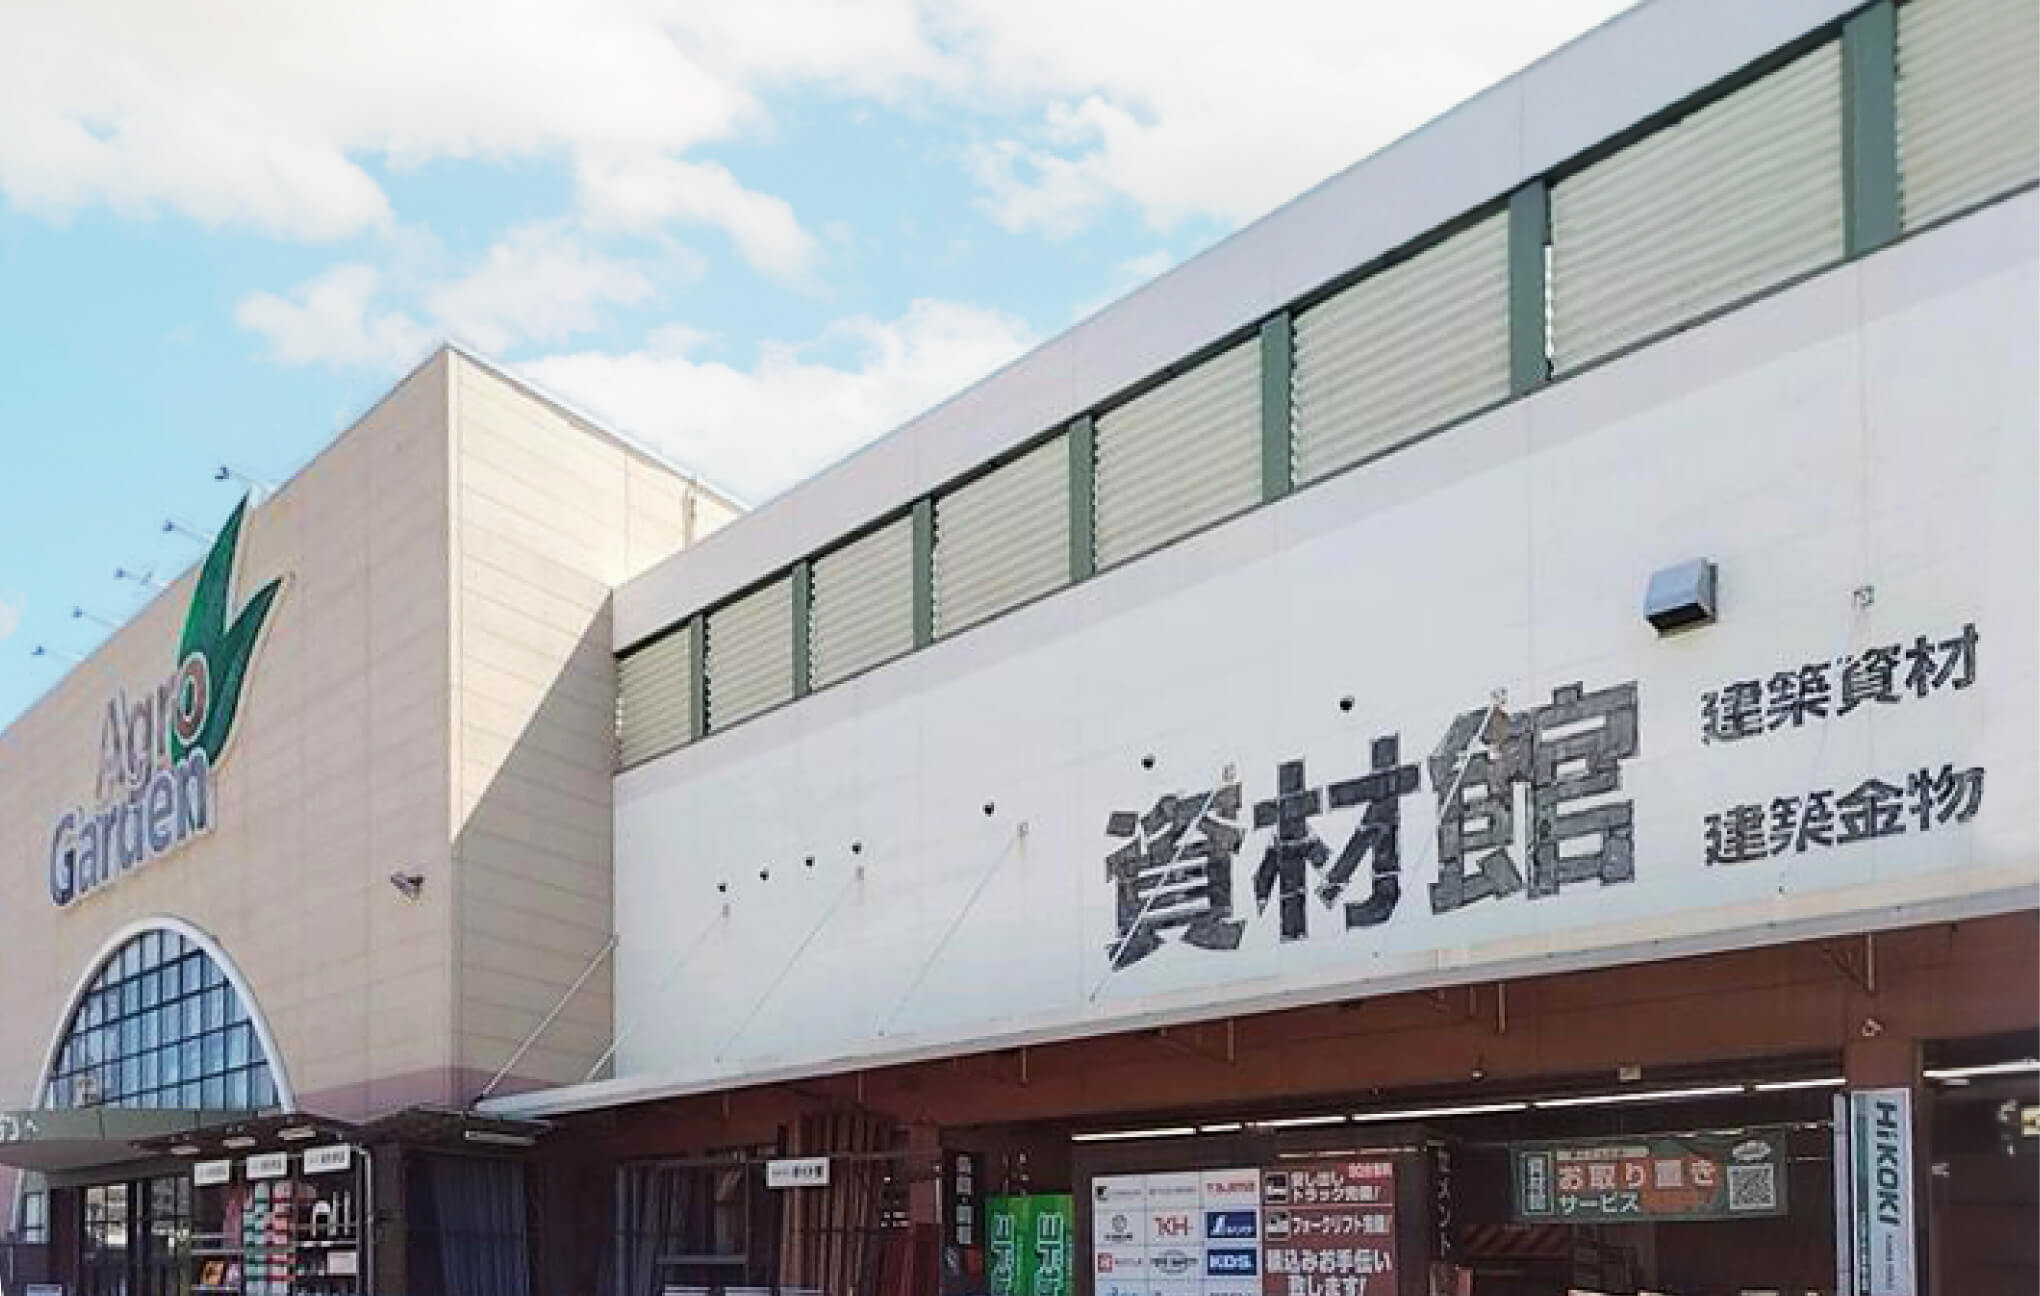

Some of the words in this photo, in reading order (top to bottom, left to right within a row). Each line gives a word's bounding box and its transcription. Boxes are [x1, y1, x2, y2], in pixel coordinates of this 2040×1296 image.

[1700, 622, 1978, 744] 建築資材
[49, 748, 212, 907] Garden
[1106, 680, 1638, 972] 資材館
[1703, 763, 1986, 866] 建築金物
[1560, 1192, 1638, 1215] サービス
